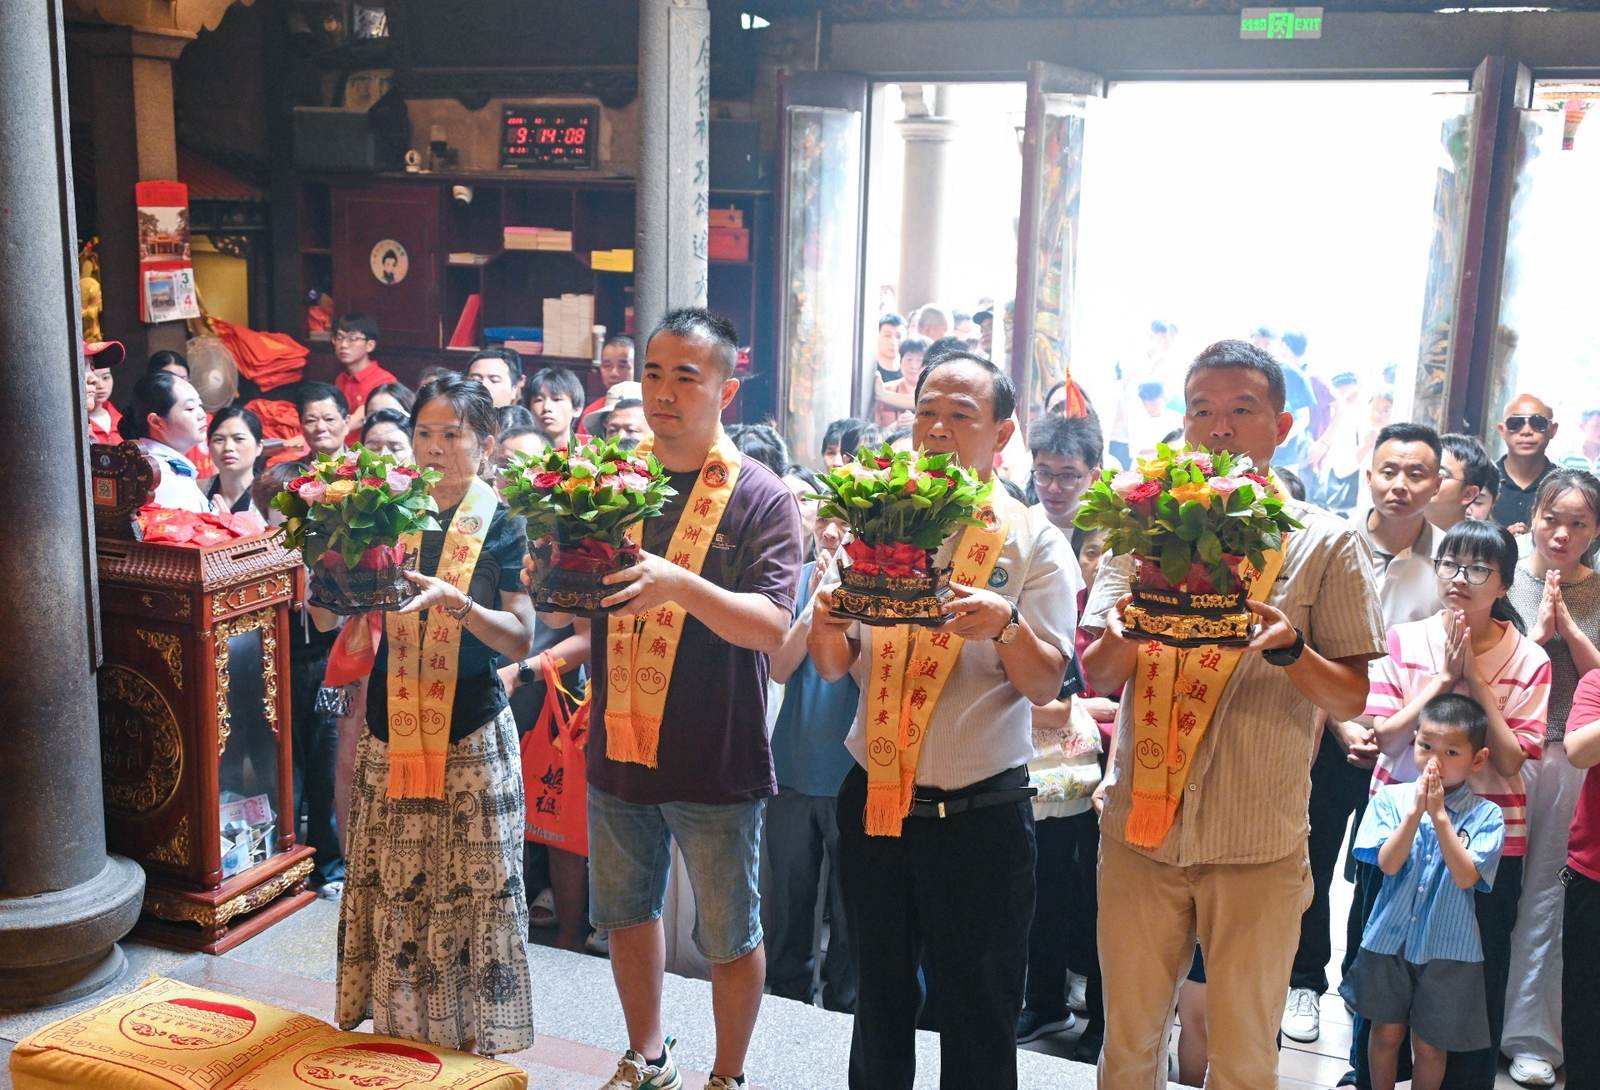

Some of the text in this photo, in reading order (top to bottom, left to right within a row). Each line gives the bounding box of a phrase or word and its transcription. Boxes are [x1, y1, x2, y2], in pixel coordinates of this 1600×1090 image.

[1295, 18, 1321, 31] EXIT
[517, 127, 585, 144] 9:14:08
[426, 544, 470, 701] 湄洲祖祖廟
[648, 496, 711, 659] 湄洲媽祖廟
[910, 543, 989, 710] 湄洲祖祖廟
